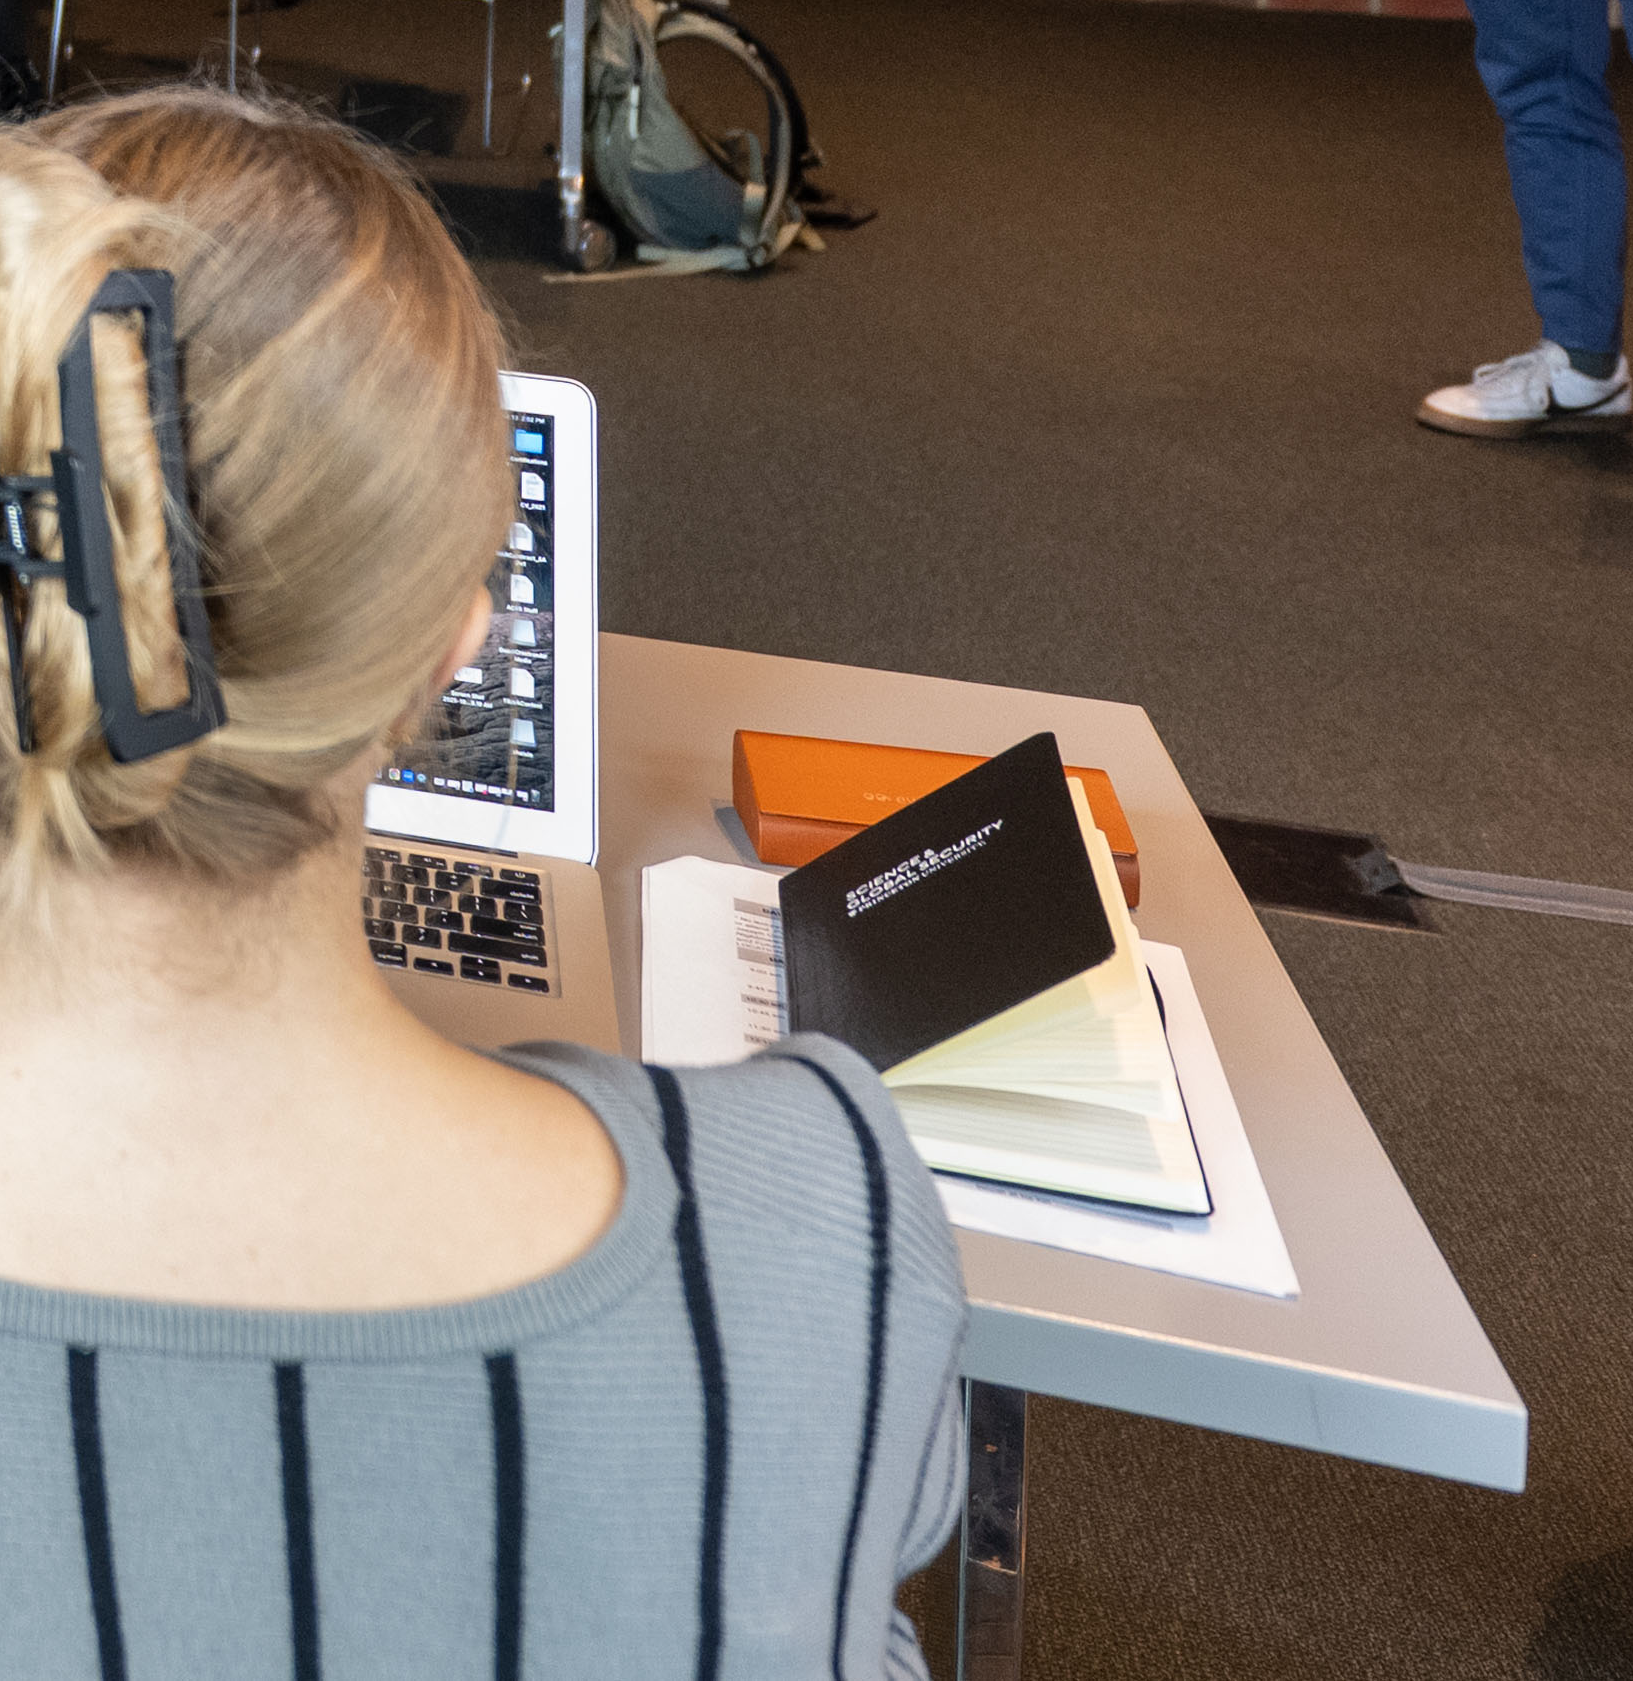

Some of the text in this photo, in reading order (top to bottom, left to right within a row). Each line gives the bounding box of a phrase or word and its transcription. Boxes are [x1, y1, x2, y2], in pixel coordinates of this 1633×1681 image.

[846, 854, 921, 902] SCIENCE
[847, 819, 1003, 910] GLOBAL SECURITY
